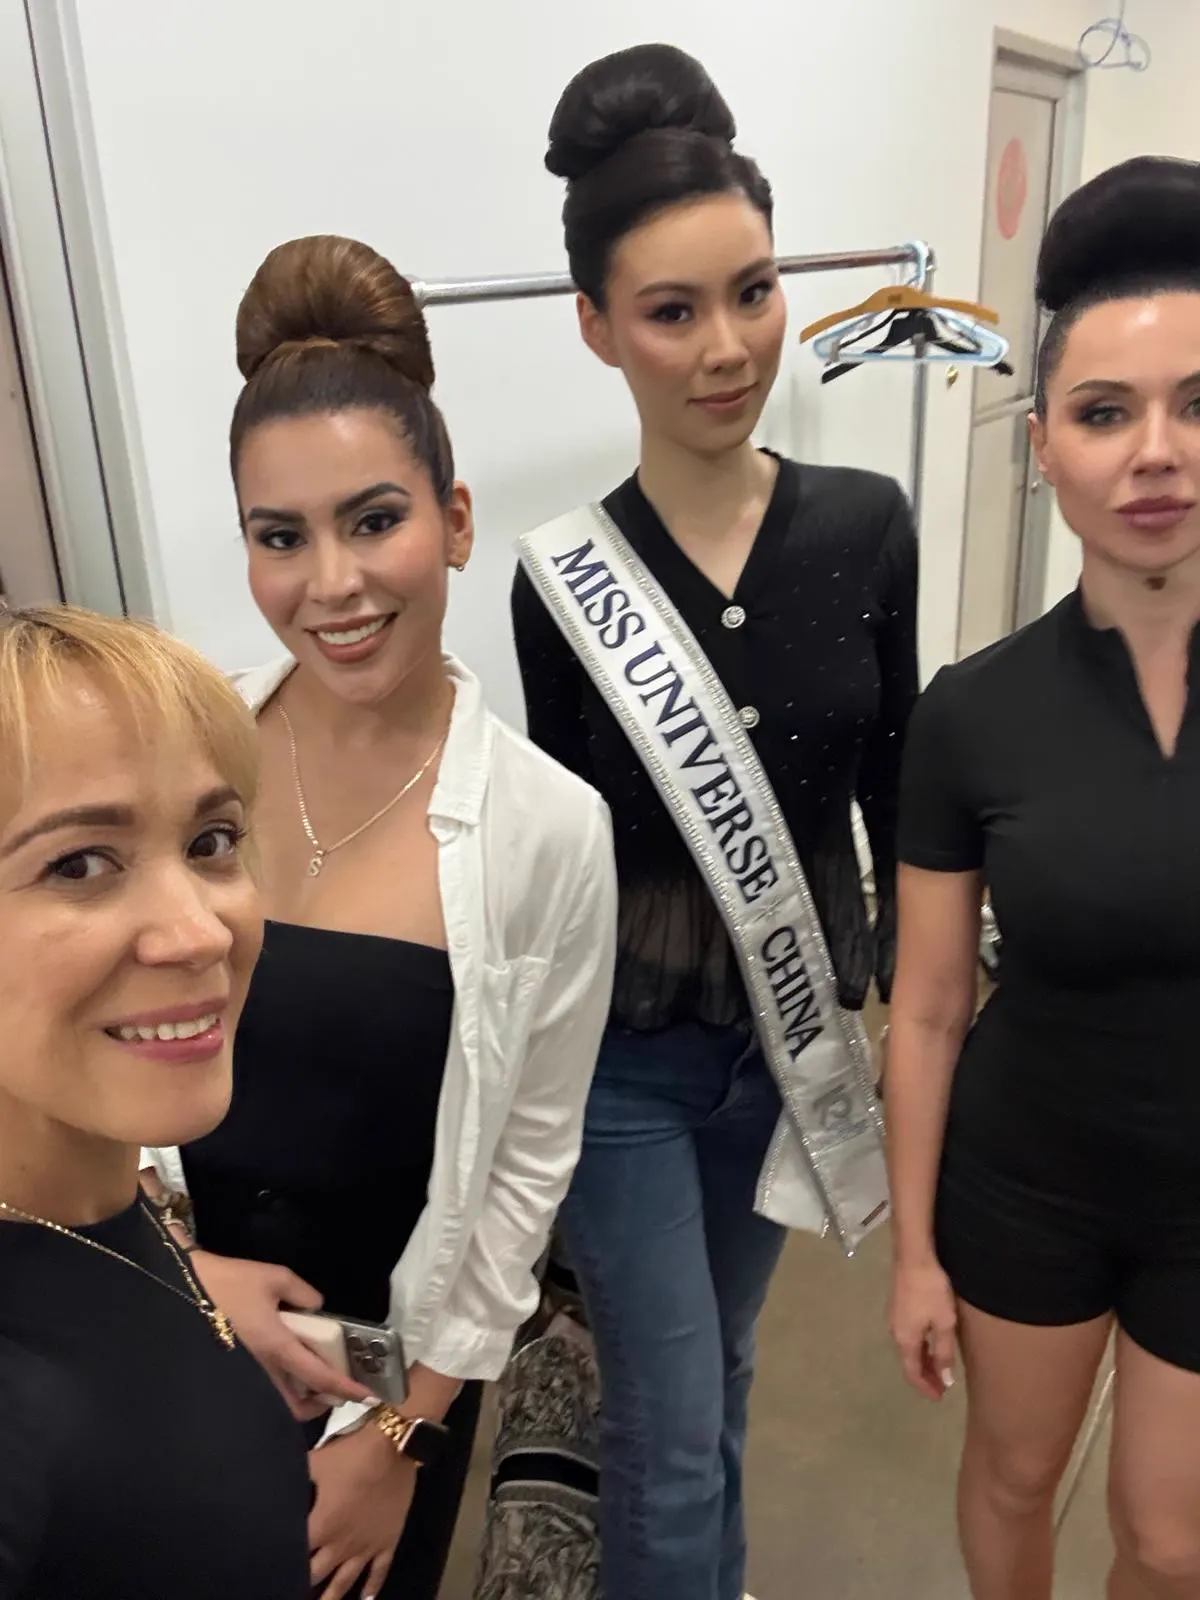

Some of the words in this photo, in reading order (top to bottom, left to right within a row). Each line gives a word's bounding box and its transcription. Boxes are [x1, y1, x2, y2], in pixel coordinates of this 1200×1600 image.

[550, 538, 646, 649] MISS
[624, 640, 779, 904] UNIVERSE
[761, 925, 824, 1062] CHINA
